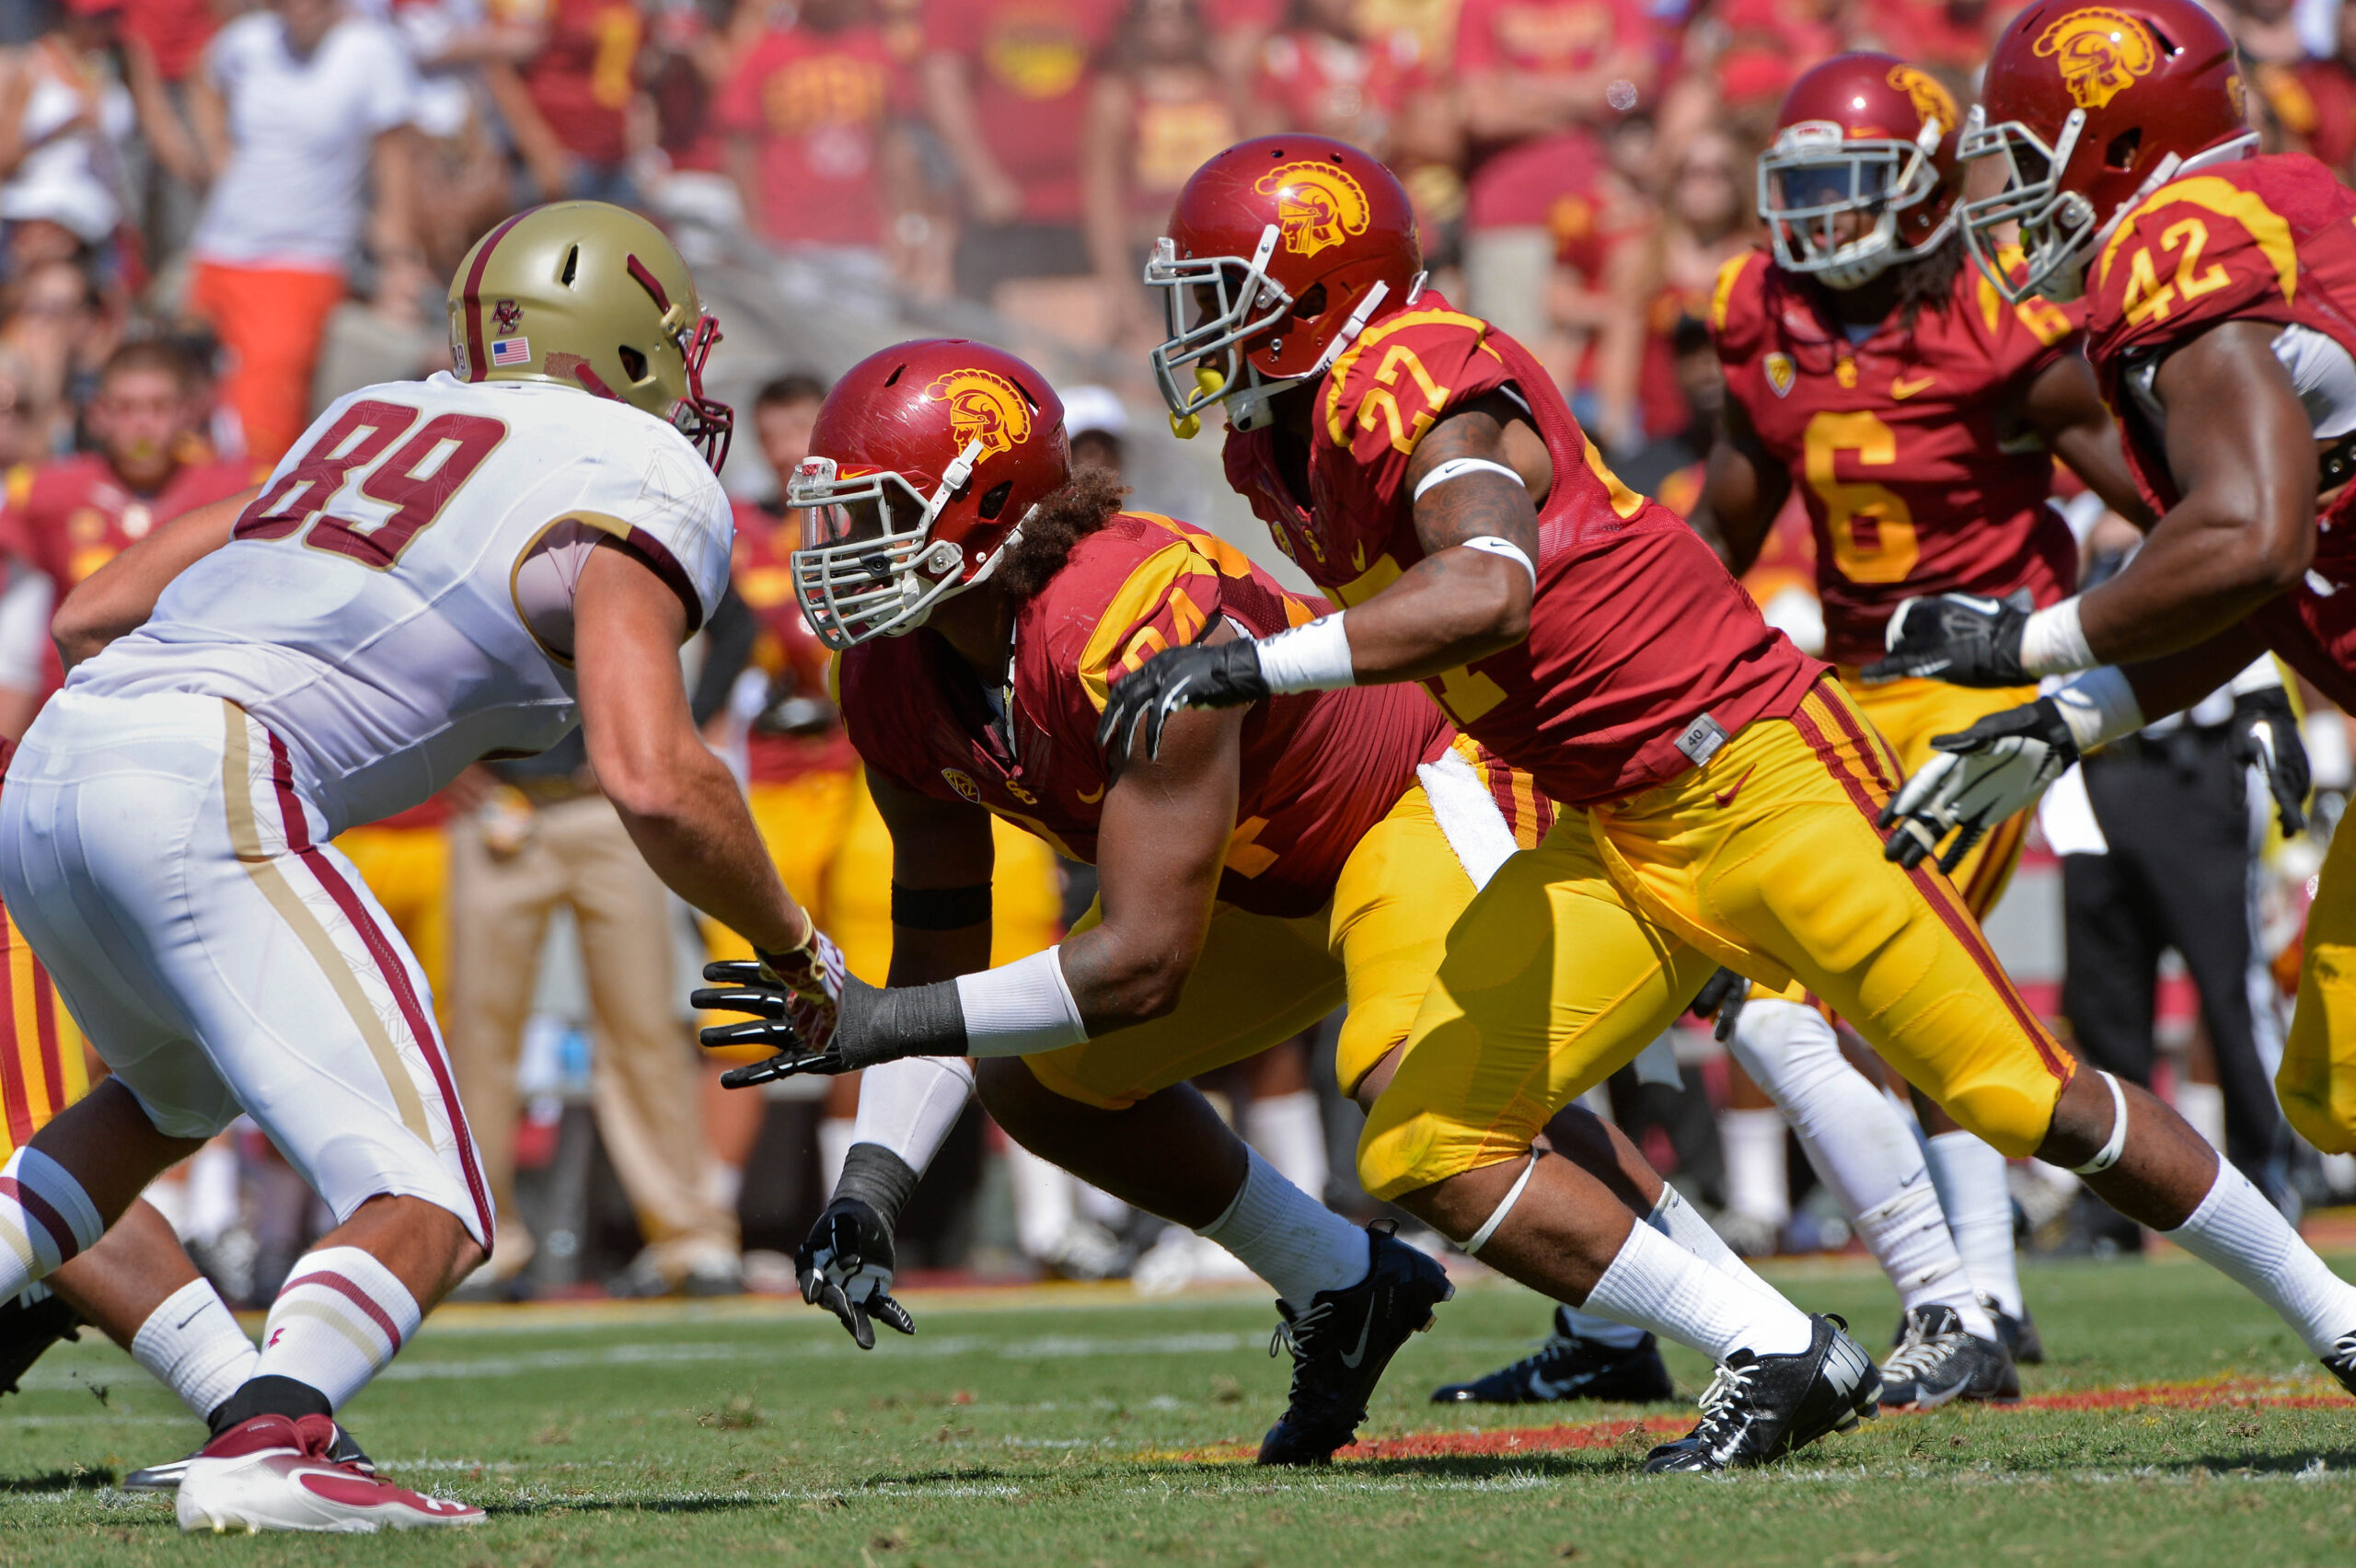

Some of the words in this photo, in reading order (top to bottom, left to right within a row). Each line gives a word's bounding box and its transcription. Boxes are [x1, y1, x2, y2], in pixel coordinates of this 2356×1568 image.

[2016, 294, 2071, 347] 6
[2123, 217, 2231, 328] 42
[452, 343, 467, 370] 89
[1357, 344, 1451, 455] 27
[232, 398, 512, 572] 89
[1804, 410, 1921, 583] 6
[1688, 729, 1703, 746] 40
